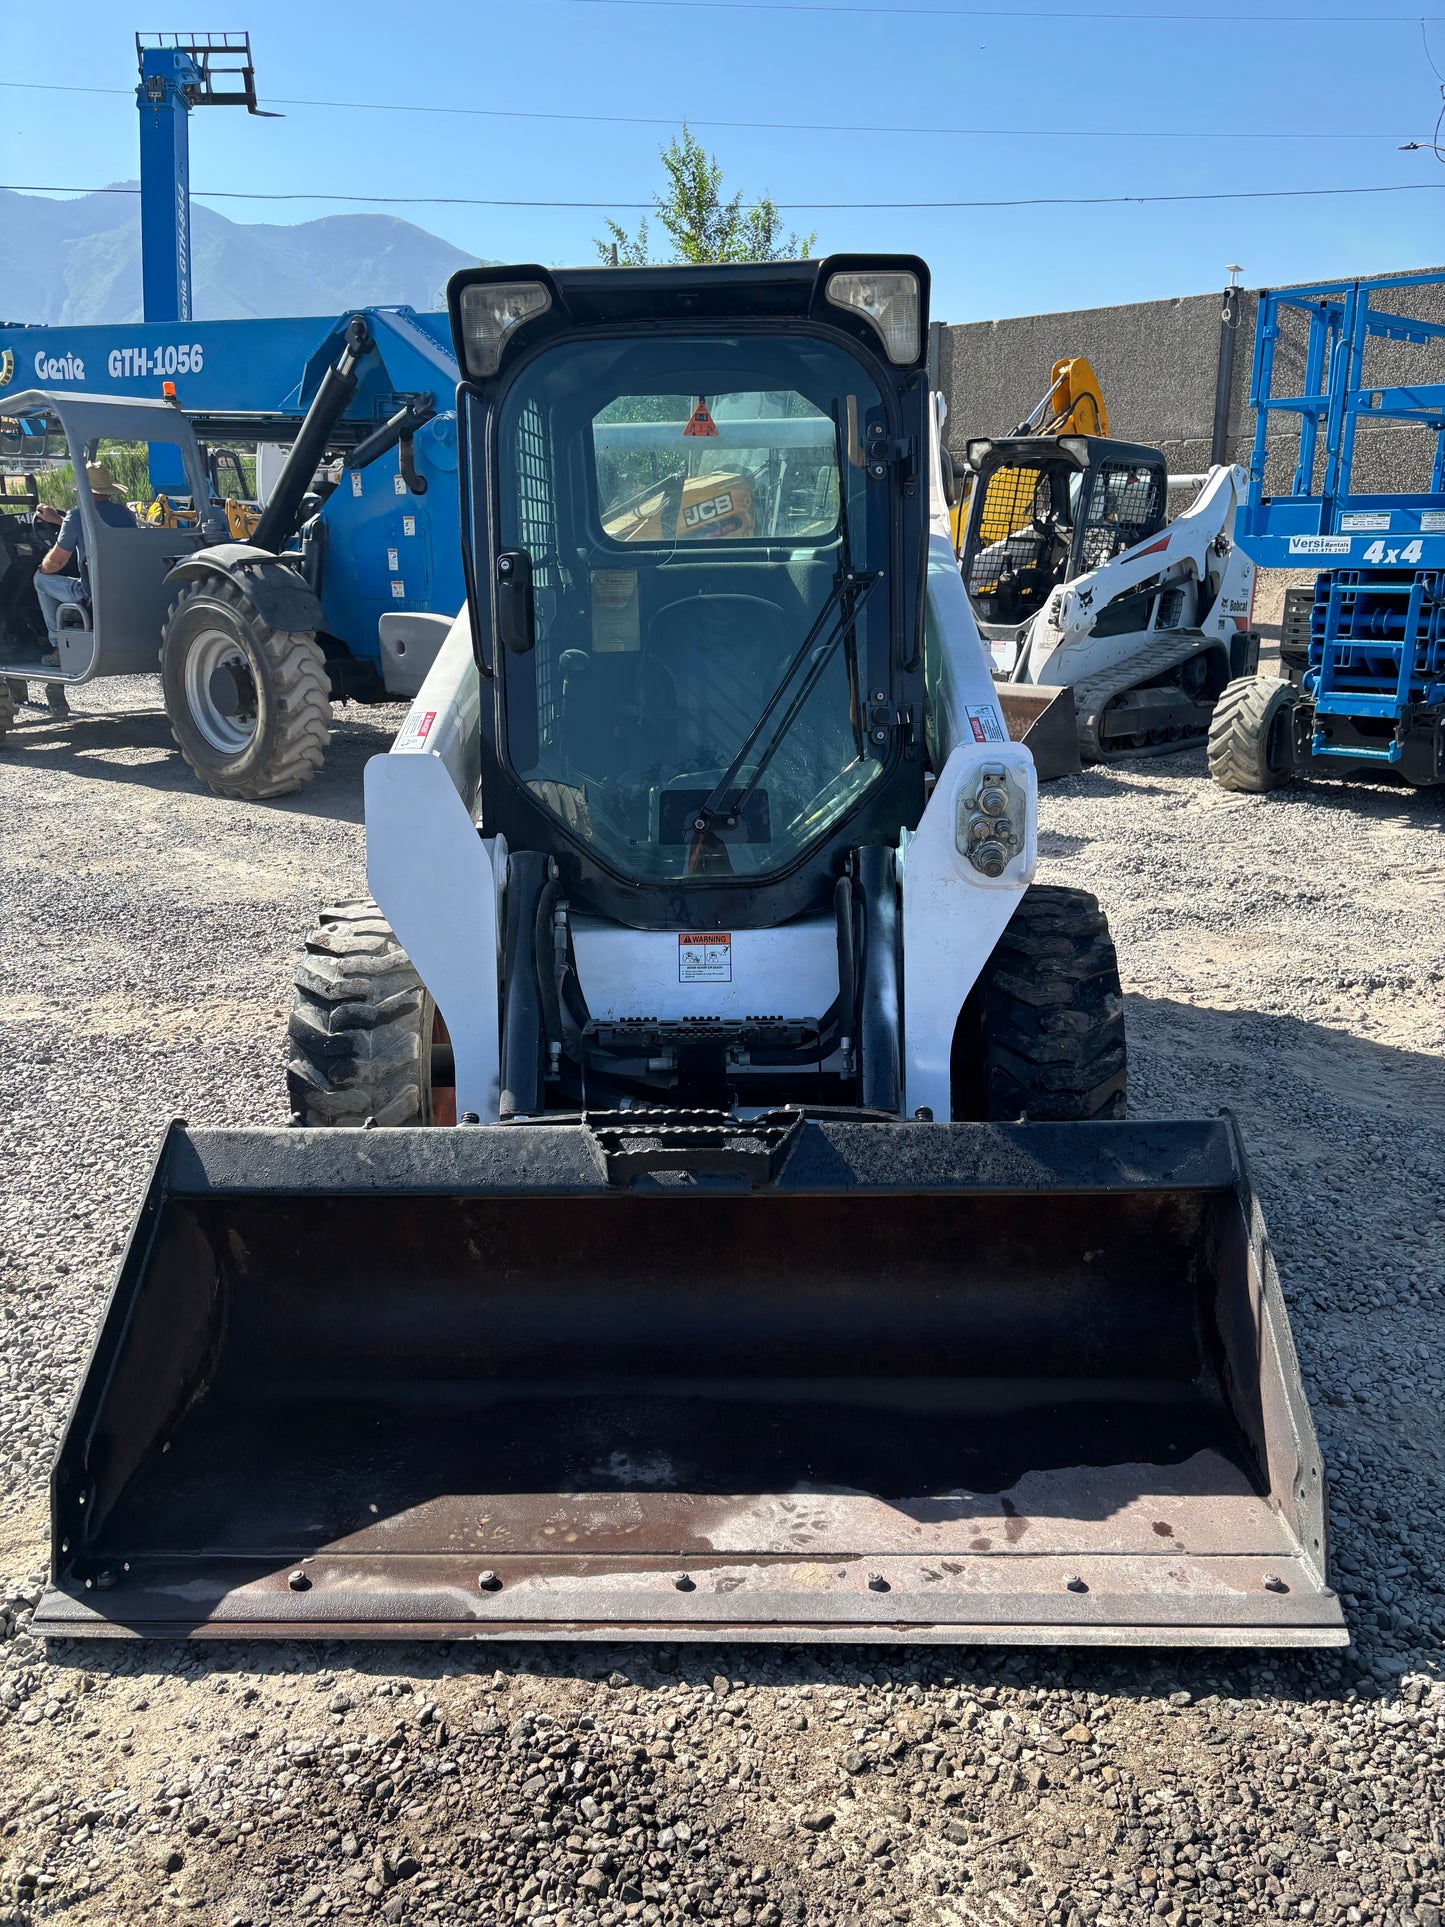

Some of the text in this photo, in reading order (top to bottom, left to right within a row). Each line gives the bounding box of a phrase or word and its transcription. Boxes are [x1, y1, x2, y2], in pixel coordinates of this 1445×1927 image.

[34, 343, 204, 380] Genie GTH-1056
[686, 494, 733, 525] JCB
[1292, 538, 1325, 548] Versi
[1362, 539, 1424, 564] 4x4
[1229, 599, 1248, 612] Bobcat
